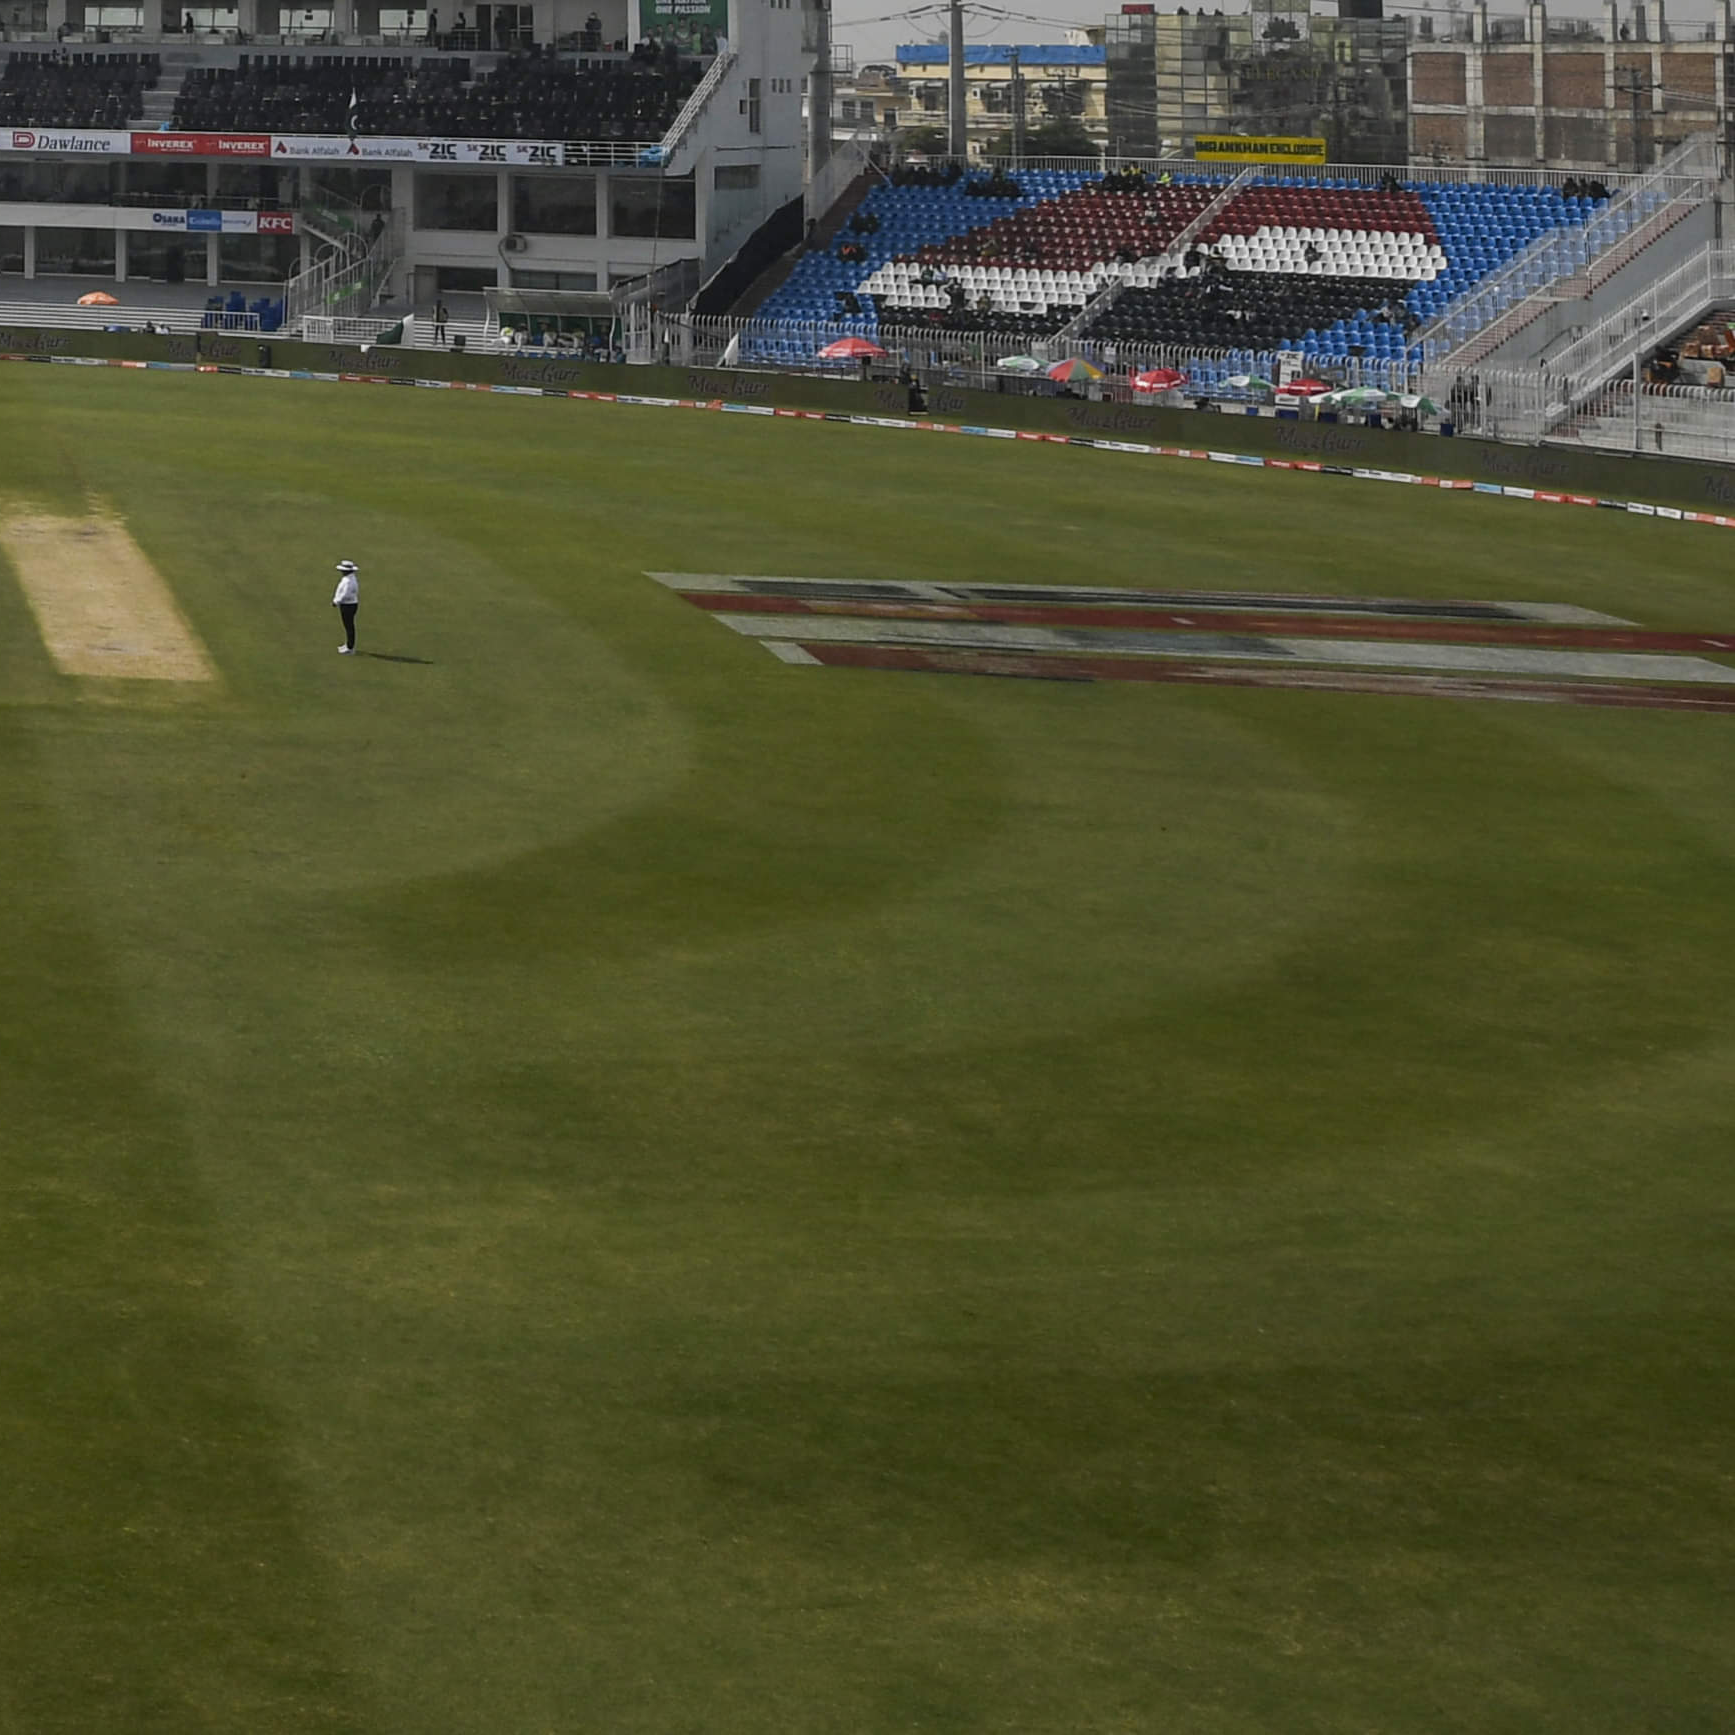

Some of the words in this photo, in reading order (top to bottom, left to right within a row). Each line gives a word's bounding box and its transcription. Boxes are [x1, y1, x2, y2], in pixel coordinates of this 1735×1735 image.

[37, 135, 111, 151] Dawlance
[430, 143, 457, 155] ZIC
[479, 144, 507, 156] ZIC
[529, 146, 557, 158] ZIC
[259, 217, 291, 229] KFC
